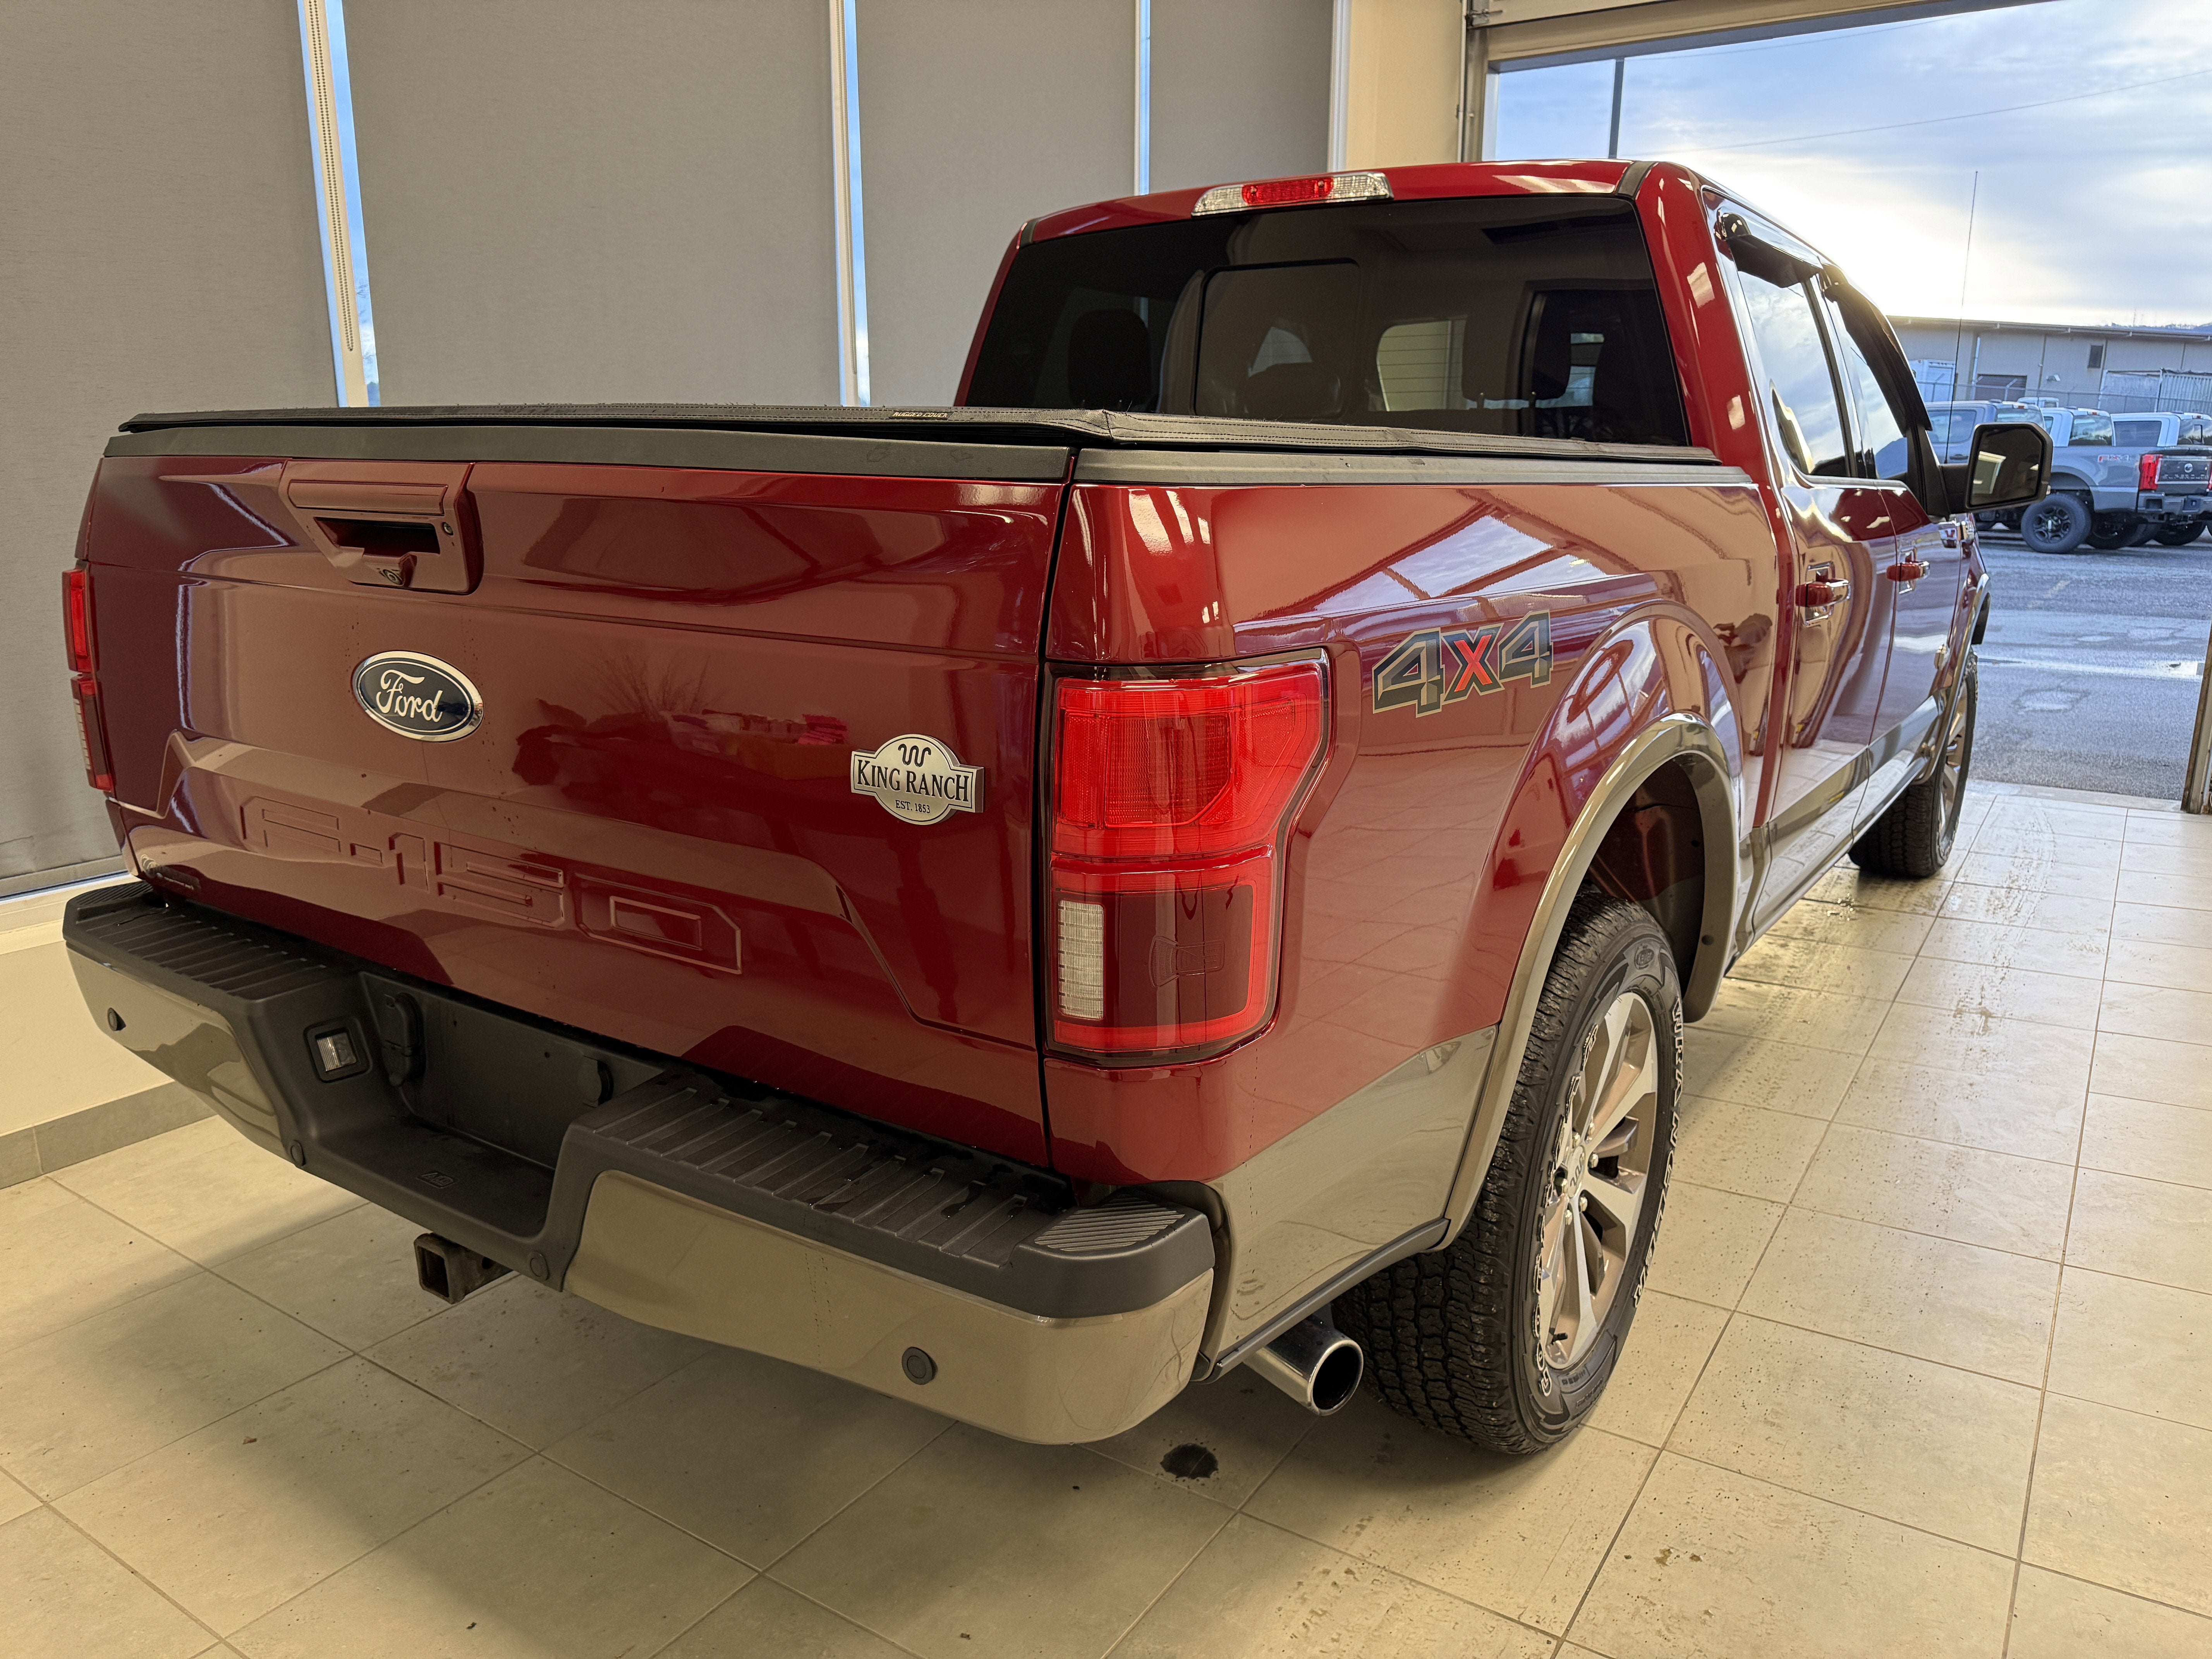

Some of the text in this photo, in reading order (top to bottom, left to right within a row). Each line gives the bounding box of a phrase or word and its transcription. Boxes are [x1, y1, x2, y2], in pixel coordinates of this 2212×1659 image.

[376, 669, 443, 722] Ford
[857, 759, 969, 802] KING RANCH
[895, 800, 931, 814] EST. 1853
[240, 796, 743, 975] F-150
